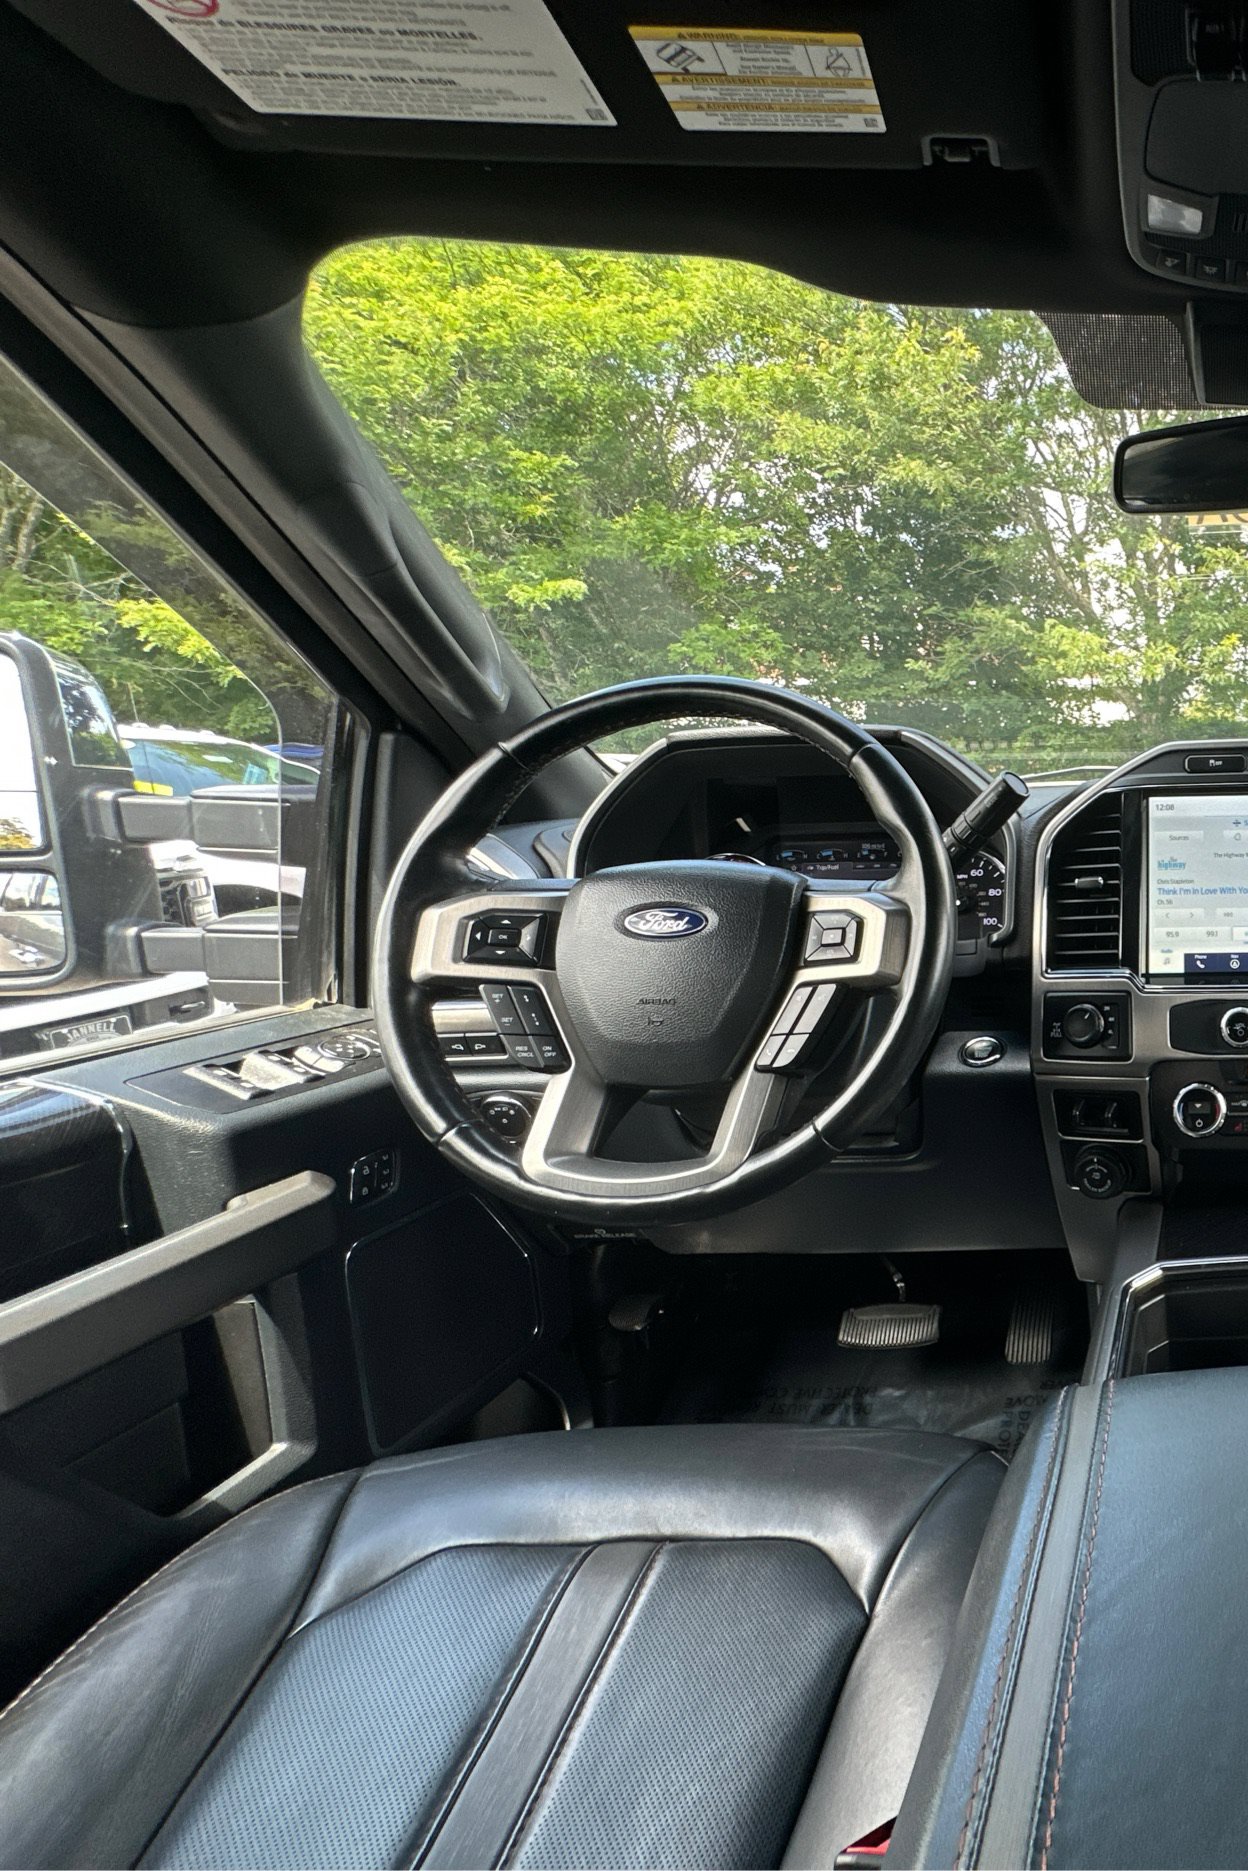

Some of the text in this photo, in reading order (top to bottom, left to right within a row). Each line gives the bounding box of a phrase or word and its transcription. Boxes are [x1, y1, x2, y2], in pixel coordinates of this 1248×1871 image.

[237, 20, 319, 32] BLESSURES
[321, 25, 376, 34] GRAVES
[220, 68, 281, 78] PELIGRO
[301, 72, 356, 81] MUERTE
[970, 869, 984, 877] 60
[988, 888, 1002, 896] 80
[1157, 887, 1180, 895] Think
[1180, 887, 1191, 895] I'm
[1201, 887, 1218, 895] Love
[639, 911, 690, 933] Ford
[983, 917, 998, 926] 100
